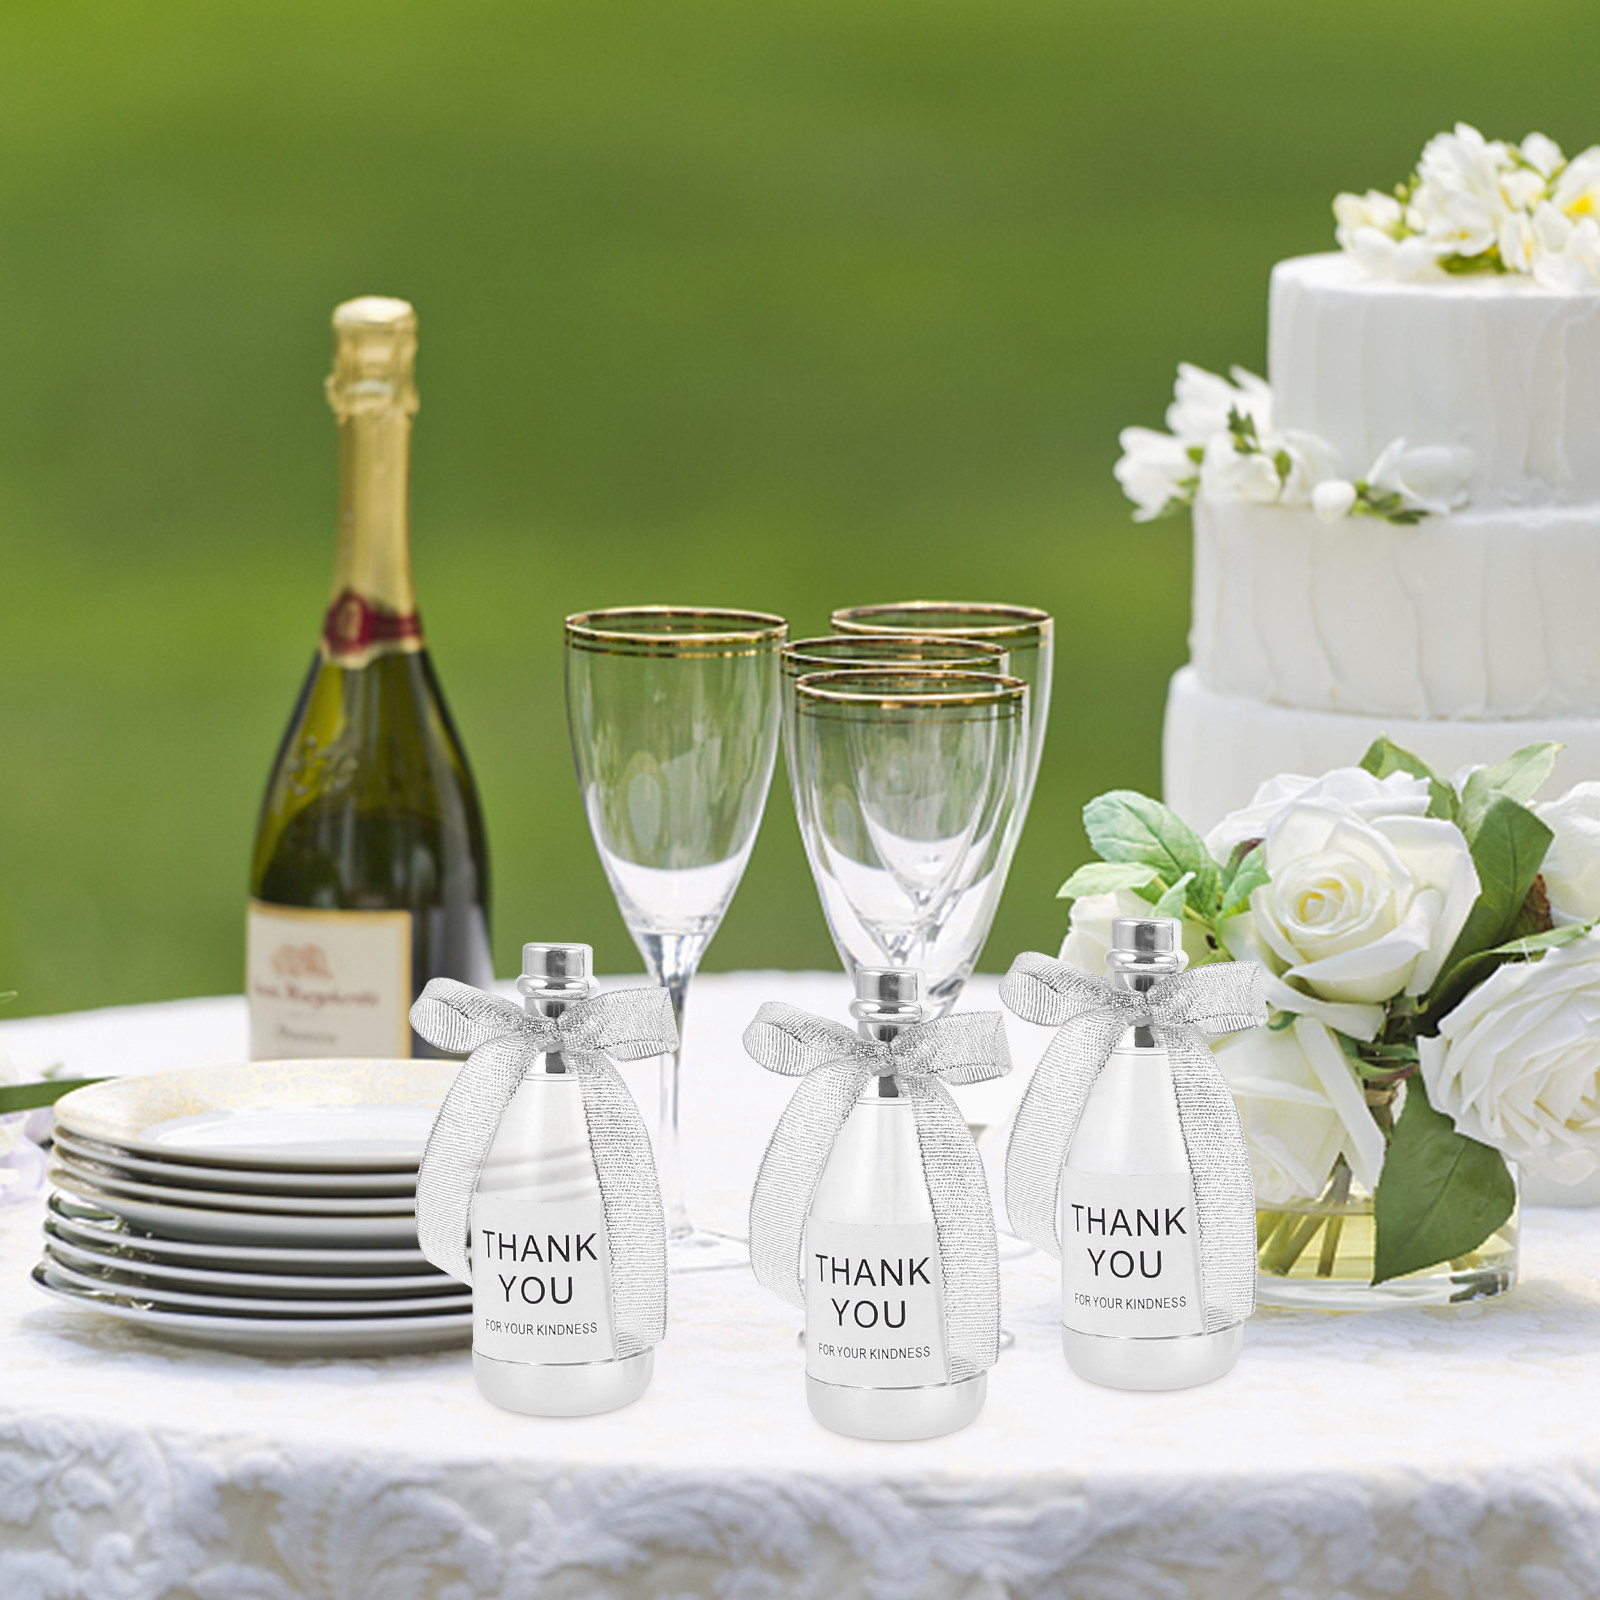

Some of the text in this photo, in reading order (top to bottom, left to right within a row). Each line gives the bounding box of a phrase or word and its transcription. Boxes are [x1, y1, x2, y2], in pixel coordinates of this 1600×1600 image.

[1071, 1203, 1187, 1236] THANK
[482, 1229, 598, 1262] THANK
[815, 1253, 931, 1286] THANK
[1087, 1248, 1162, 1278] YOU
[498, 1274, 573, 1304] YOU
[1074, 1292, 1187, 1310] FOR YOUR KINDNESS
[485, 1318, 598, 1336] FOR YOUR KINDNESS
[831, 1298, 906, 1328] YOU
[818, 1342, 931, 1360] FOR YOUR KINDNESS
